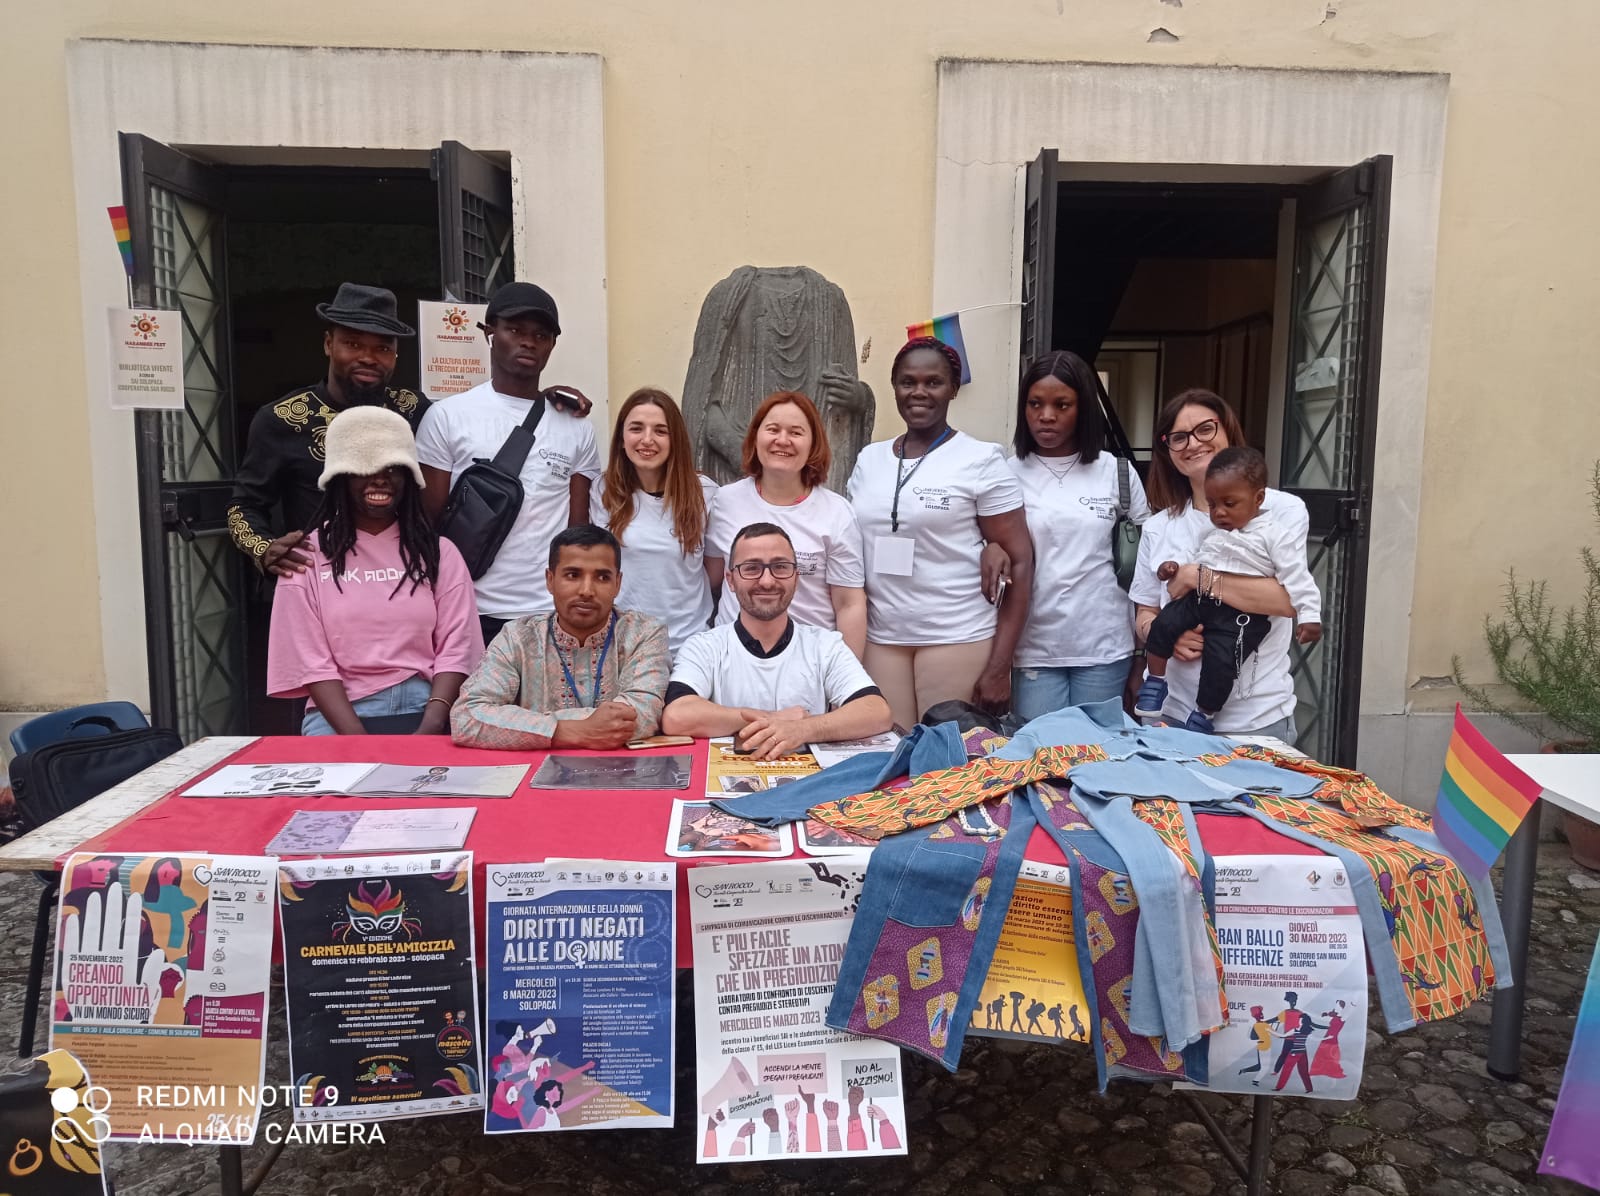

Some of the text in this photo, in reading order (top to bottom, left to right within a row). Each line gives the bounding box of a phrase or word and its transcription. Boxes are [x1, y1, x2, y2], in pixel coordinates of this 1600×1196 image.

[214, 868, 261, 878] SAN ROCCO
[713, 883, 729, 891] SAN
[504, 905, 643, 916] GIORNATA INTERNAZIONALE DELLA DONNA
[1013, 901, 1041, 911] diritto
[775, 916, 795, 924] CONTRO
[1033, 911, 1063, 921] umano
[503, 917, 644, 941] DIRITTI NEGATI
[1289, 921, 1318, 932] GIOVEDÌ
[712, 929, 791, 953] E' PIU FACILE
[1218, 929, 1284, 947] RAN BALLO
[1289, 934, 1347, 944] 30 MARZO 2023
[301, 940, 456, 958] CARNEVALE DELL'AMICIZIA
[503, 940, 625, 964] ALLE DONNE
[312, 958, 348, 966] domenica
[729, 948, 789, 972] SPEZZARE
[792, 945, 810, 965] UN
[1289, 960, 1317, 968] SOLOPACA
[69, 963, 124, 985] CREANDO
[716, 964, 839, 994] CHE UN PREGIUDIZIO
[516, 976, 557, 988] MERCOLEDÌ
[1262, 980, 1293, 988] APARTHEID
[68, 982, 150, 1007] OPPORTUNITÀ
[503, 989, 557, 1000] 8 MARZO 2023
[717, 992, 756, 1005] LABORATORIO
[757, 992, 763, 1001] DI
[763, 988, 797, 999] CONFRONTO
[798, 988, 804, 997] DI
[520, 1000, 557, 1011] SOLOPACA
[719, 1004, 742, 1015] CONTRO
[742, 1002, 773, 1013] PREGIUDIZI
[778, 998, 810, 1009] STEREOTIPI
[74, 1006, 150, 1021] IN UN MONDO SICURO
[764, 1016, 772, 1028] 15
[773, 1013, 800, 1027] MARZO
[801, 1011, 821, 1024] 2023
[721, 1038, 742, 1046] incontro
[753, 1034, 780, 1043] beneficiari
[800, 1030, 828, 1039] studentesse
[722, 1047, 735, 1055] della
[825, 1036, 842, 1044] Sociale
[764, 1064, 790, 1073] ACCENDI
[801, 1063, 822, 1071] MENTE
[855, 1063, 883, 1074] NO AL
[763, 1074, 785, 1082] SPEGNI
[848, 1072, 894, 1088] RAZZISMO!
[747, 1091, 760, 1101] ALLE
